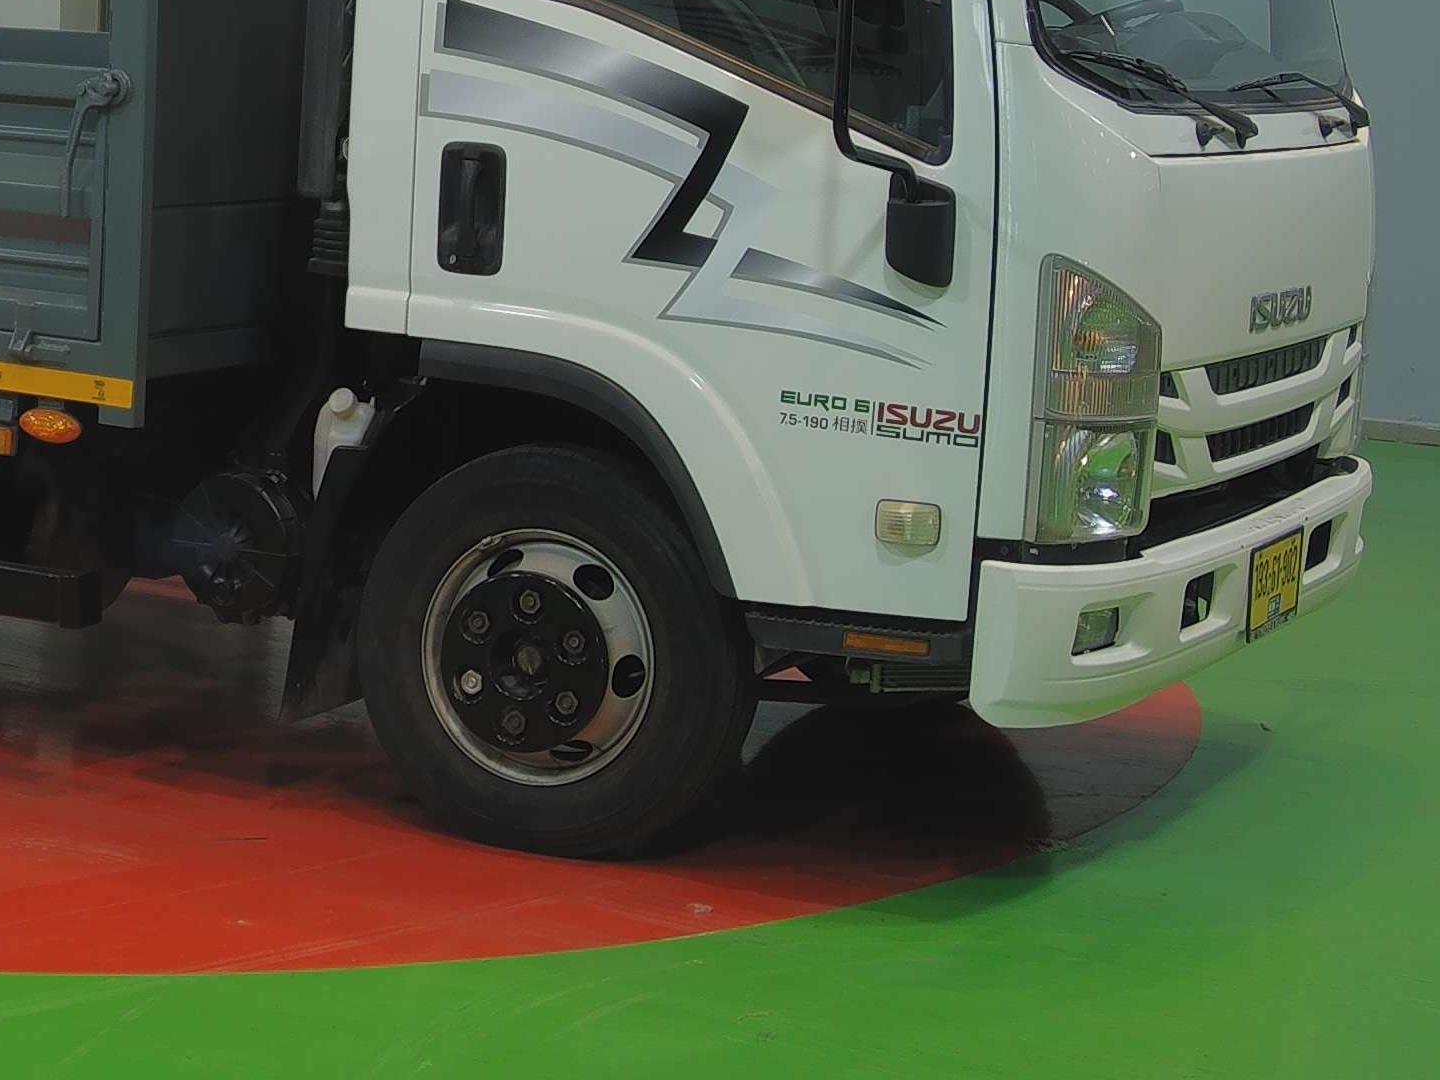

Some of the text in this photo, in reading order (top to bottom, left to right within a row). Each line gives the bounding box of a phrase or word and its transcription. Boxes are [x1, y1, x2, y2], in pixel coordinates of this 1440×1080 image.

[1249, 285, 1312, 333] ISUZU
[780, 390, 870, 413] EURO 6
[878, 402, 981, 434] ISUZU
[876, 424, 979, 448] SUMO
